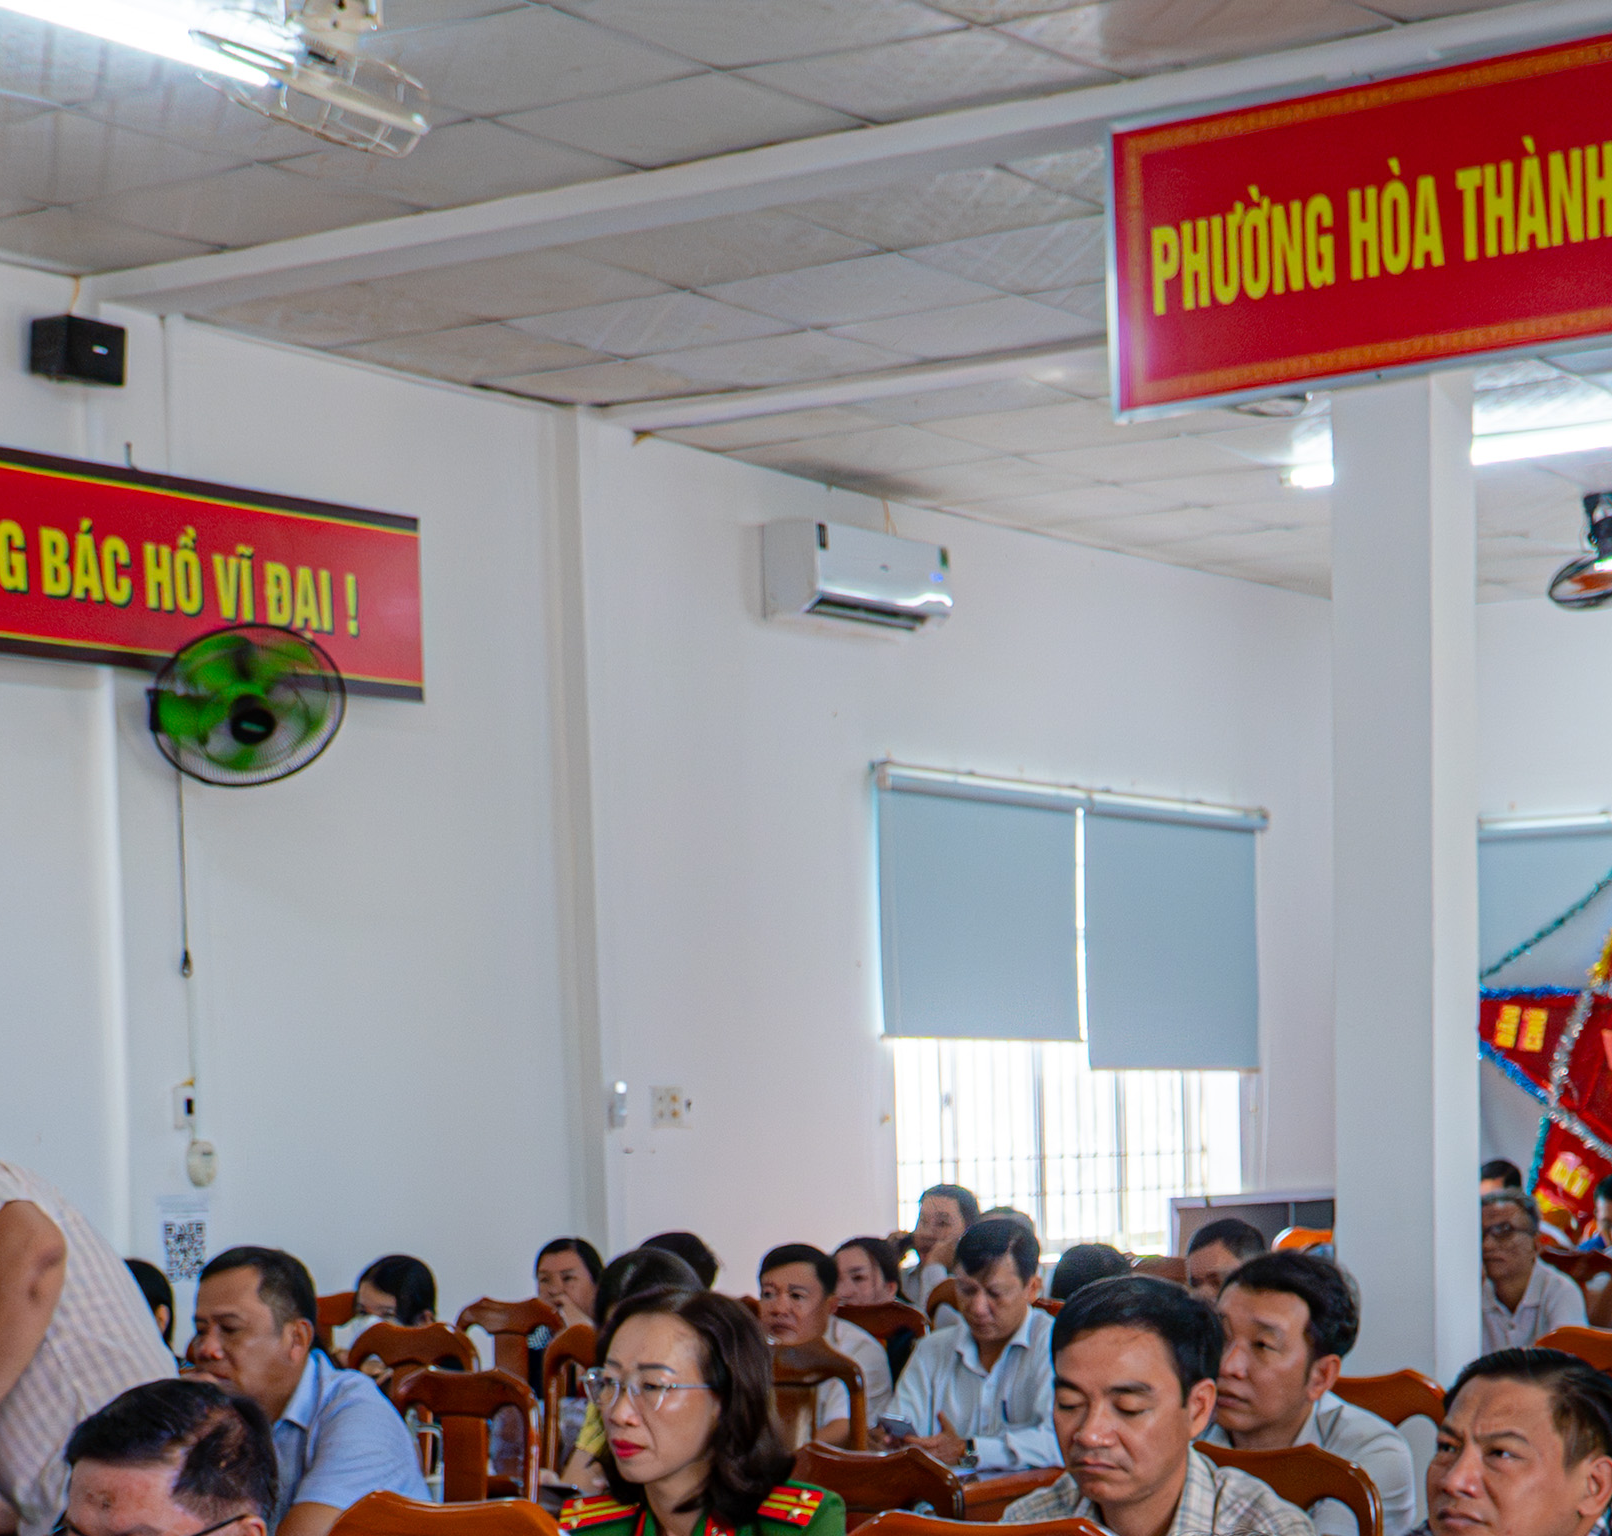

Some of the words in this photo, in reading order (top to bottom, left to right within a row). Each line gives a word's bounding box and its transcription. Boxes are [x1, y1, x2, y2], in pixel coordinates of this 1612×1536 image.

[1151, 186, 1335, 316] PHƯỜNG
[1349, 157, 1445, 280] HÒA
[40, 518, 132, 605] BÁC
[143, 525, 203, 616] HỒ
[212, 544, 255, 623] VĨ
